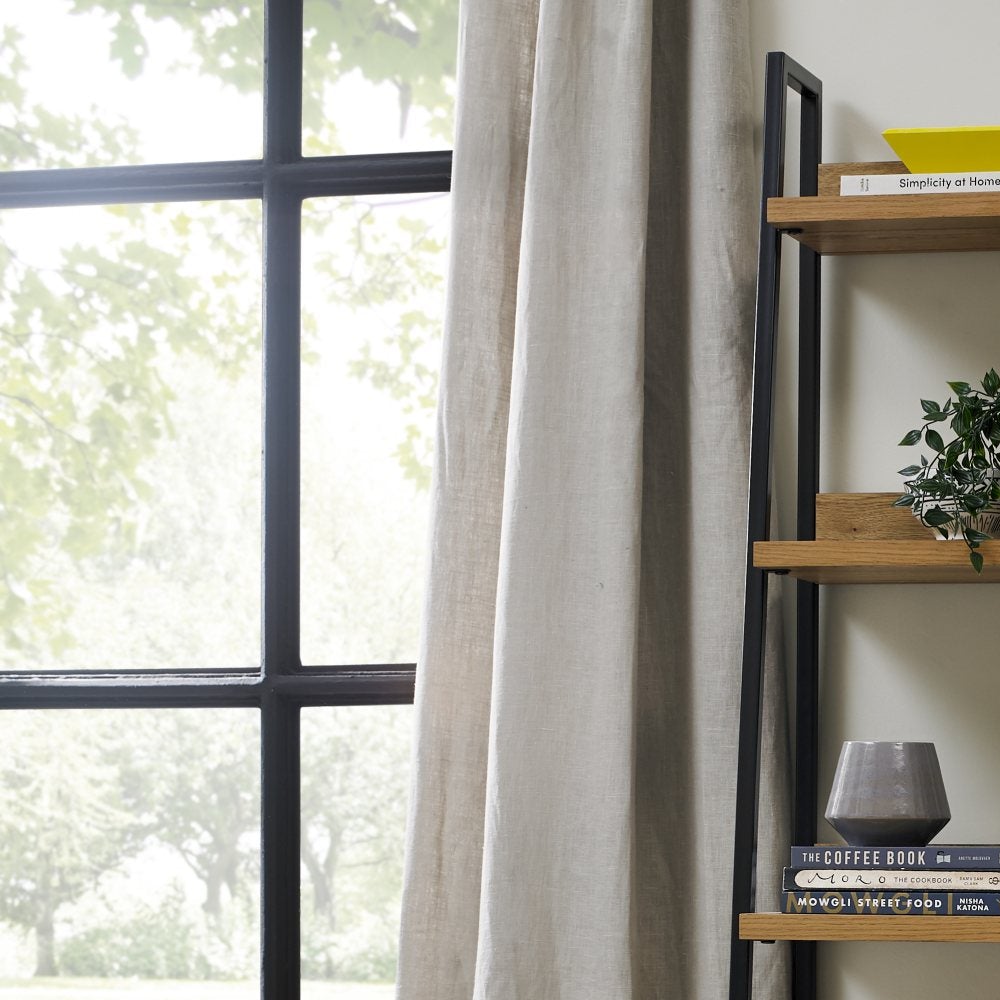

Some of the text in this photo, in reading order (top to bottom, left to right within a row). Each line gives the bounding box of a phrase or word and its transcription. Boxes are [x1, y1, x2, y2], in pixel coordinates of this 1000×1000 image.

[899, 177, 1000, 190] Simplicity at Home
[802, 850, 926, 866] THE COFFEE BOOK
[910, 876, 953, 884] COOKBOOK
[797, 897, 942, 908] MOWGLI STREET FOOD
[959, 897, 985, 905] NISHA
[956, 904, 990, 912] KATONA
